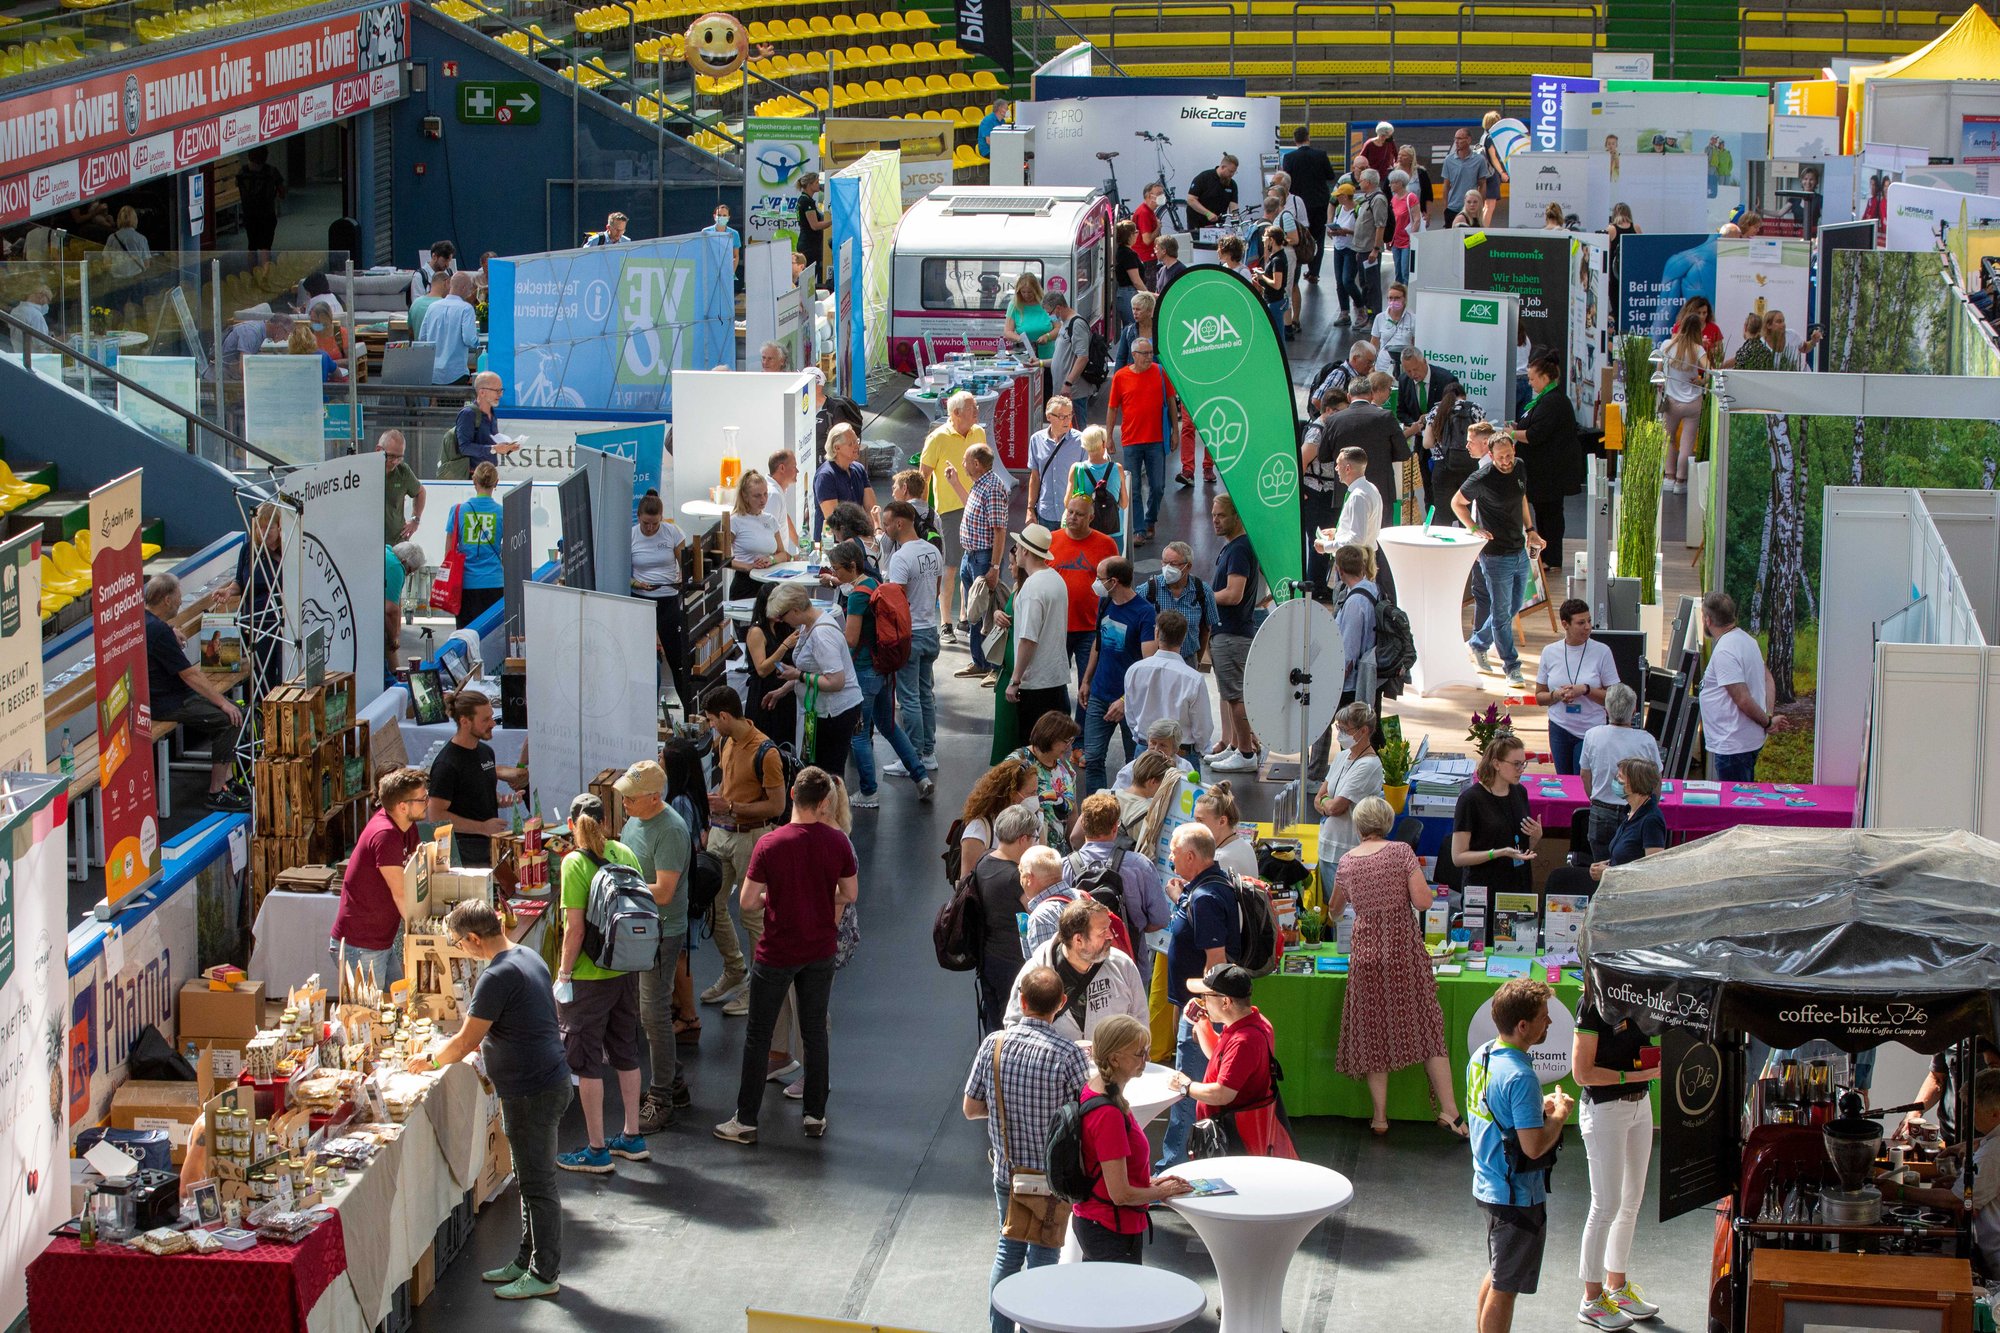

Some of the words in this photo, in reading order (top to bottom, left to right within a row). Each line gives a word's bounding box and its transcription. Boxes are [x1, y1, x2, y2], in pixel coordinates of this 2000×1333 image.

[960, 0, 984, 42] bik
[145, 67, 206, 122] EINMAL
[210, 52, 252, 103] LÖWE
[265, 41, 312, 87] IMMER
[316, 26, 354, 73] LÖWE!
[1047, 108, 1083, 125] F2-PRO
[1180, 107, 1247, 120] bike2care
[1536, 82, 1557, 152] dheit
[0, 108, 59, 163] MMER
[64, 88, 119, 144] LÖWE!
[748, 123, 791, 131] Physiotherapie
[1047, 125, 1083, 139] E-Faltrad
[900, 173, 944, 190] press
[0, 179, 27, 214] KON
[1905, 206, 1933, 216] HERBALIFE
[1490, 249, 1543, 260] thermomix
[1492, 273, 1509, 283] Wir
[1512, 273, 1539, 283] haben
[1508, 285, 1542, 295] Zutaten
[1629, 281, 1647, 292] Bei
[1651, 283, 1671, 292] uns
[1526, 297, 1541, 306] Job
[1628, 296, 1686, 307] trainieren
[1467, 304, 1492, 316] AOK
[1521, 308, 1548, 318] ebens!
[1628, 311, 1645, 321] Sie
[1649, 311, 1669, 321] mit
[1424, 350, 1467, 366] Hessen,
[1470, 355, 1488, 365] wir
[1470, 369, 1496, 381] über
[1613, 393, 1625, 402] C9
[498, 444, 576, 468] kstat
[633, 473, 650, 482] ODE
[111, 512, 125, 528] daily
[124, 507, 134, 520] five
[99, 572, 136, 603] Smoothies
[100, 608, 113, 625] neu
[114, 590, 144, 621] gedacht.
[8, 683, 39, 713] BESSER!
[0, 912, 11, 939] GA
[104, 947, 172, 1074] Pharma
[0, 999, 33, 1043] RKEITEN
[1649, 1011, 1664, 1022] Mobile
[1665, 1015, 1686, 1026] Coffee
[1686, 1018, 1709, 1031] Company
[1847, 1027, 1871, 1035] Mobile
[1873, 1027, 1894, 1036] Coffee
[1895, 1027, 1926, 1037] Company
[1527, 1050, 1566, 1060] itsamt
[1543, 1063, 1566, 1071] Main
[0, 1084, 34, 1136] AIGA.BIO
